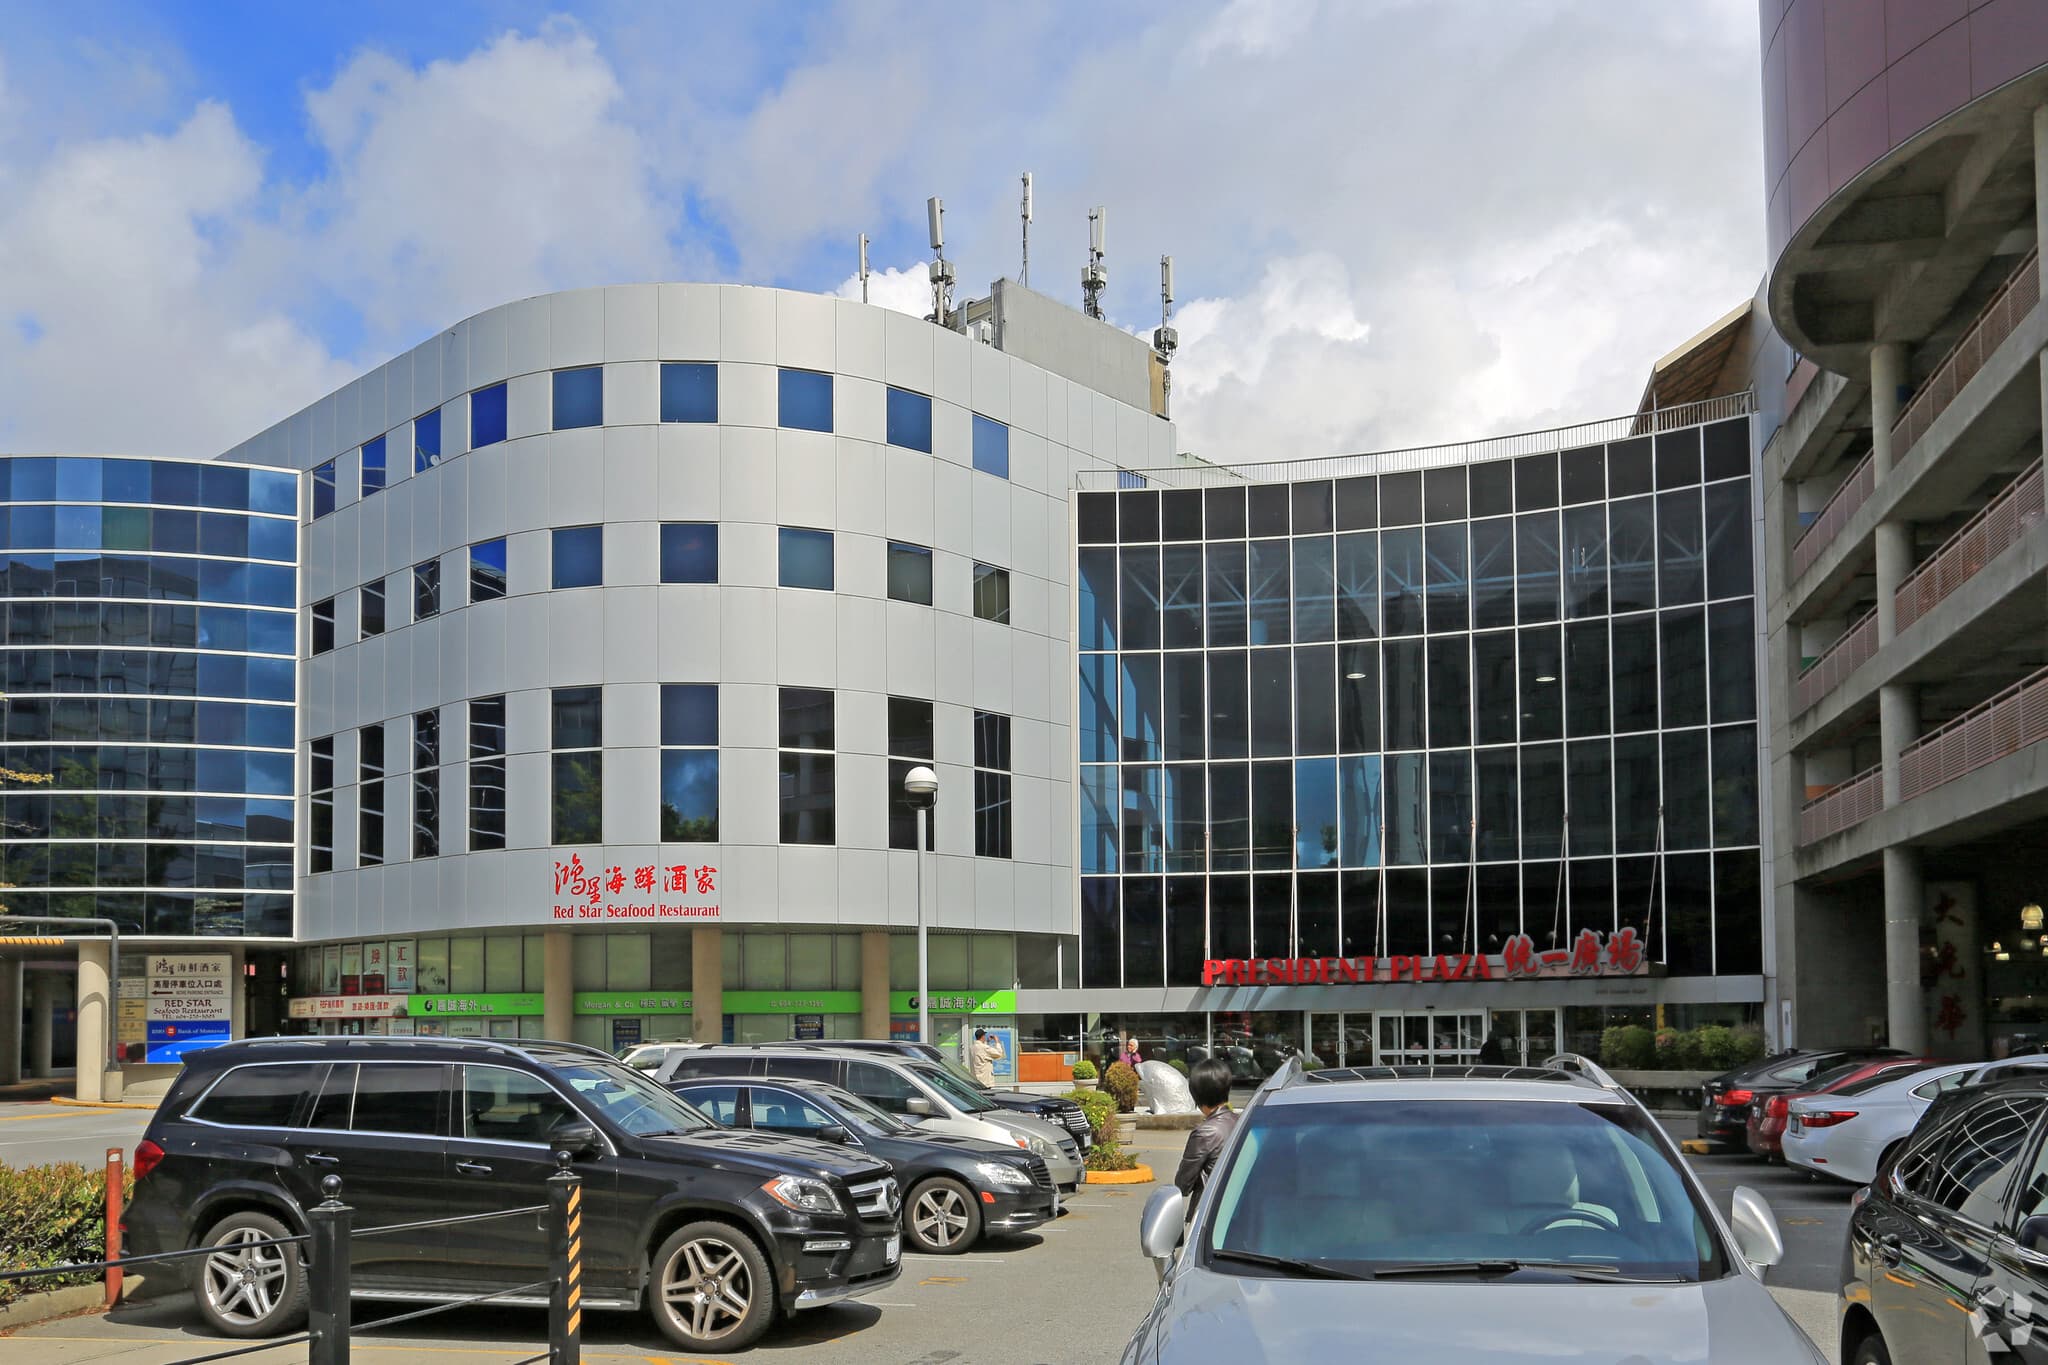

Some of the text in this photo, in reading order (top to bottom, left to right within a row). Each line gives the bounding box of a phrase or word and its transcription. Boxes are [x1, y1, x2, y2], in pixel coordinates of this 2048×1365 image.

[554, 904, 720, 918] Red Star Seafood Restaurant
[1203, 954, 1493, 985] PRESIDENT PLAZA
